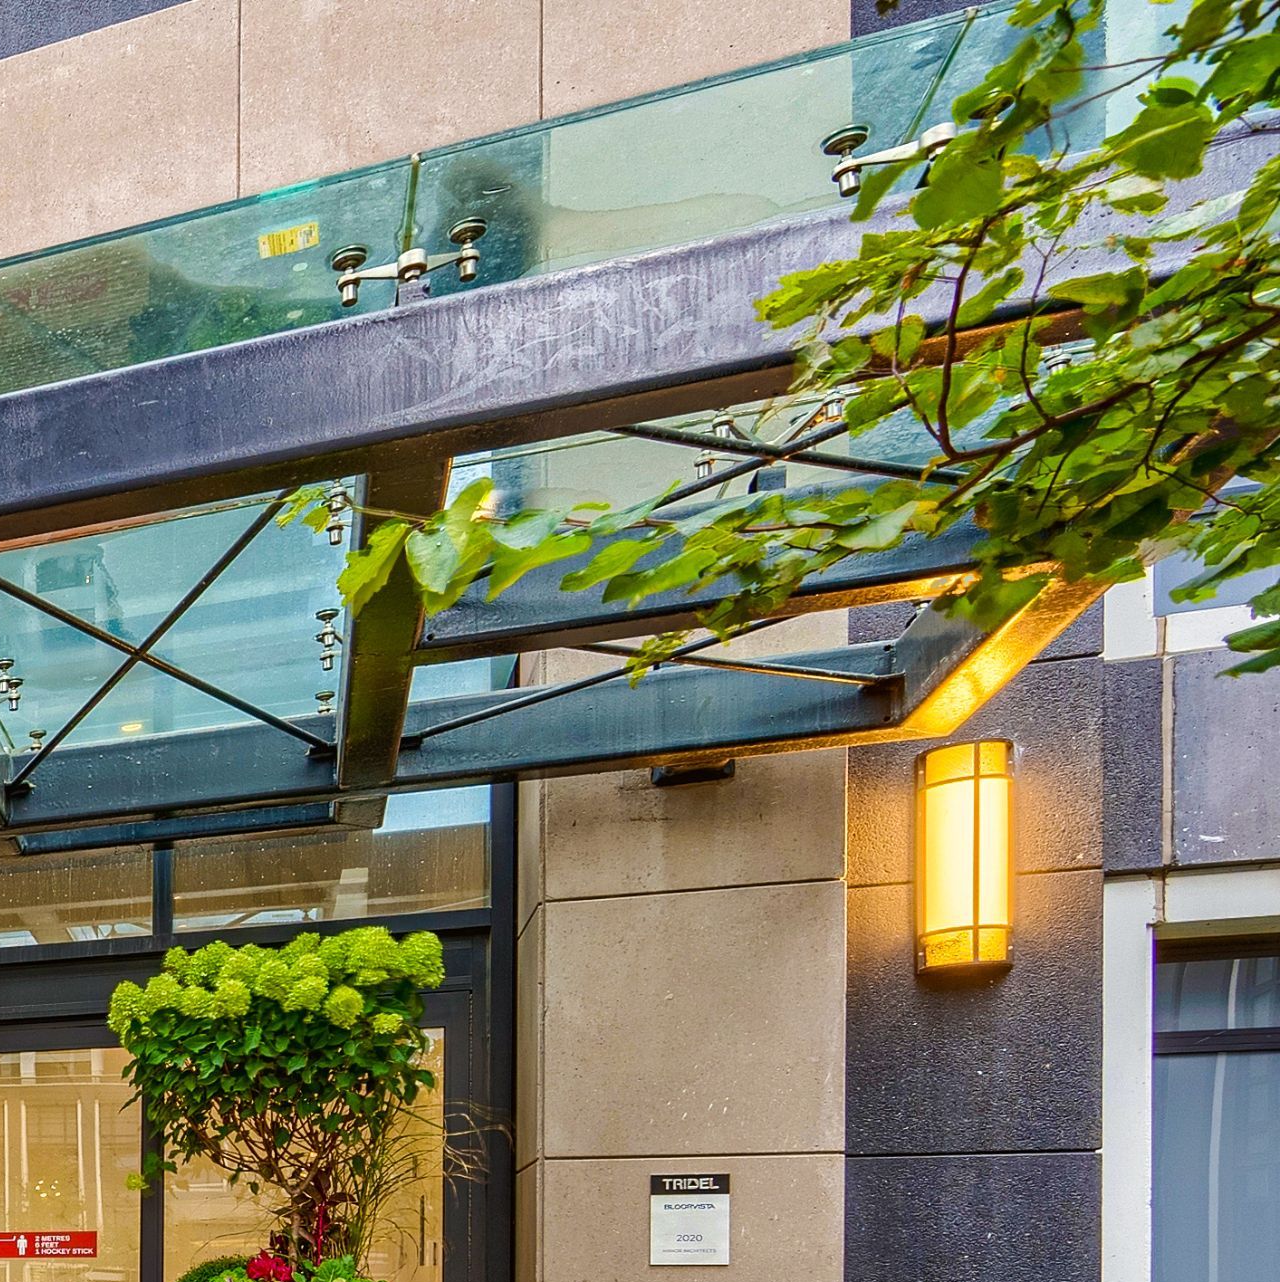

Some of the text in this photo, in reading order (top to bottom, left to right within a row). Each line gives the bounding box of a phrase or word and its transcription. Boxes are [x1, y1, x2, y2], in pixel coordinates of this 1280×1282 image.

[662, 1178, 719, 1190] TRIDEL
[676, 1234, 703, 1242] 2020
[71, 1247, 94, 1255] STICK
